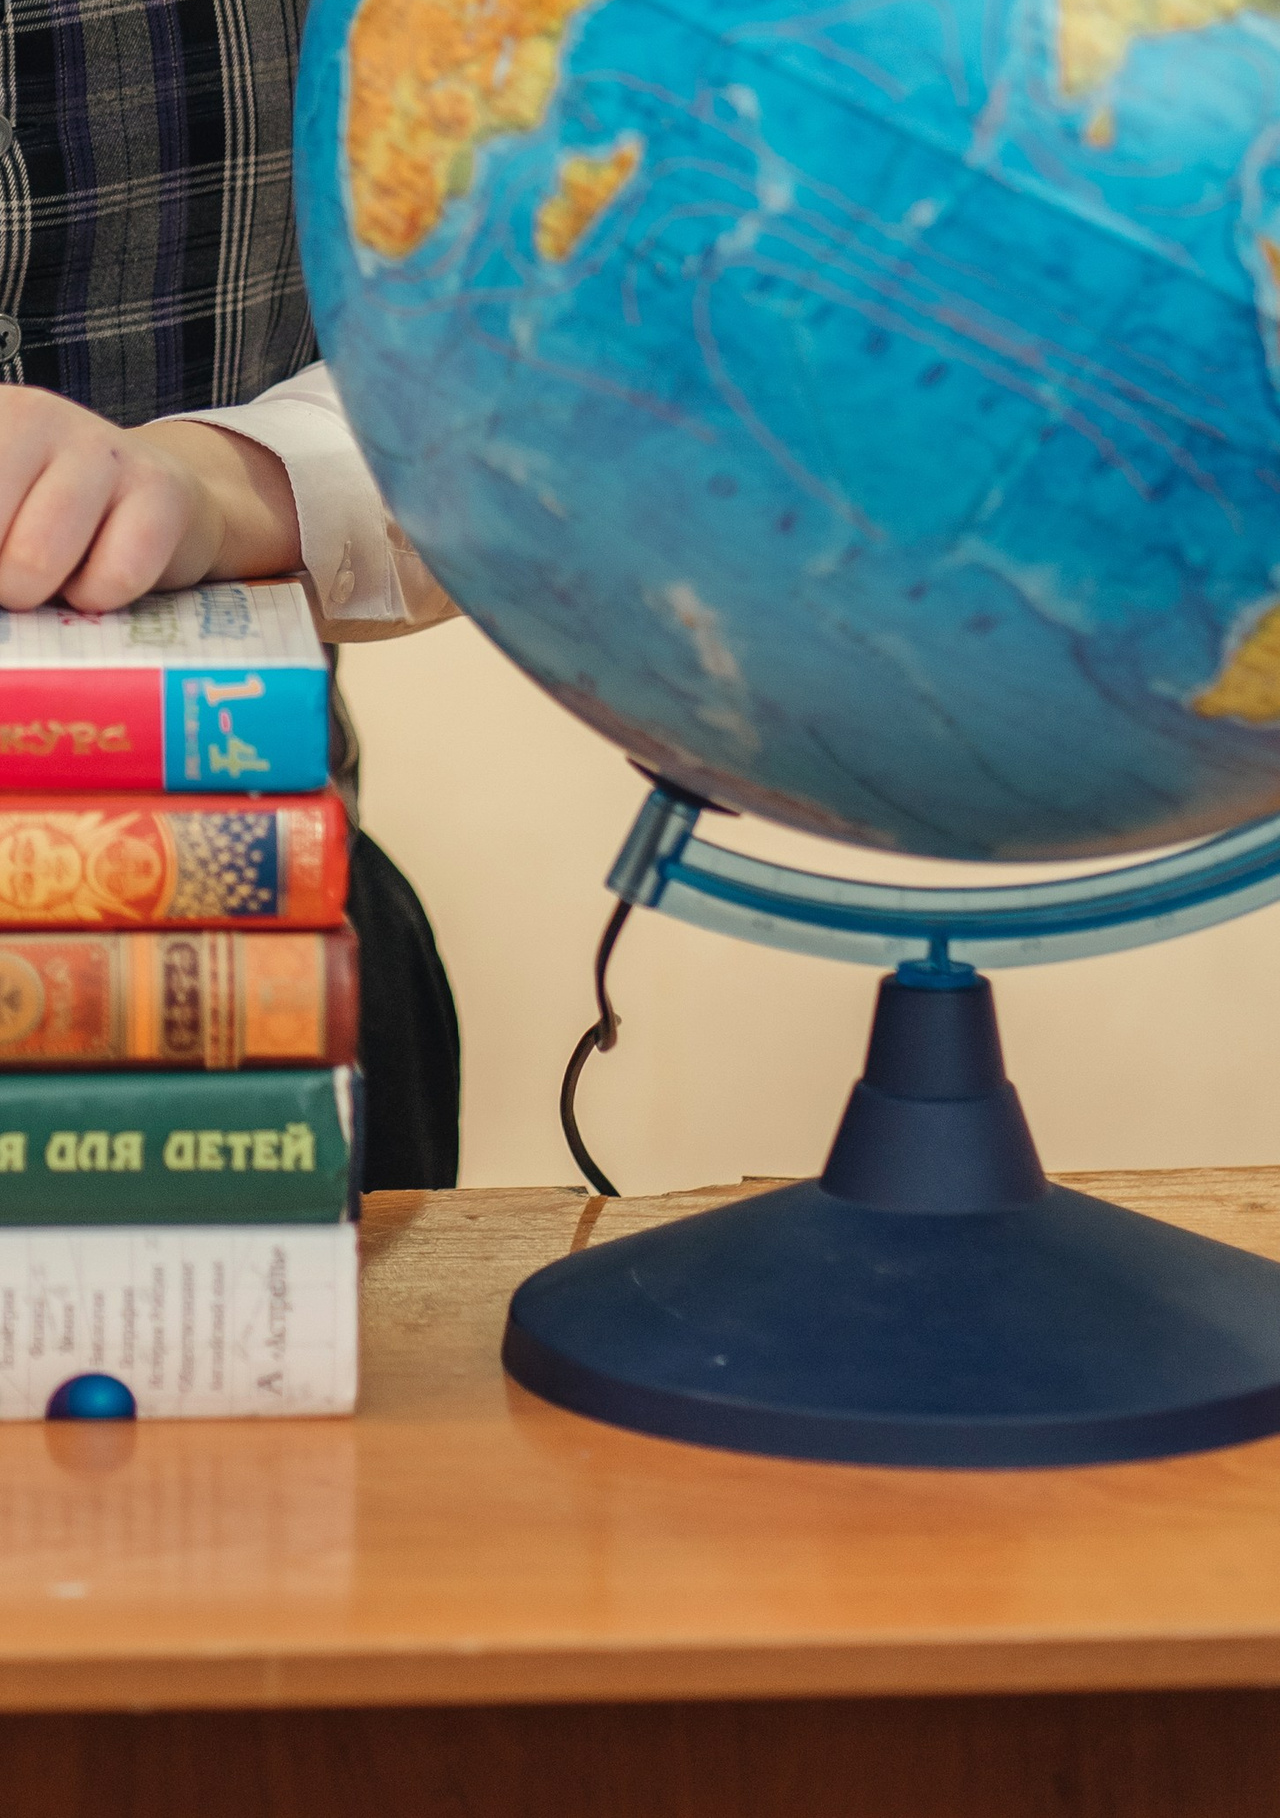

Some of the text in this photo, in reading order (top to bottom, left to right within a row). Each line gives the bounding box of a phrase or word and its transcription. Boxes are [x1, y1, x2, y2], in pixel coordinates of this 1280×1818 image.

[205, 673, 271, 779] 1-4
[45, 1129, 143, 1174] ДЛЯ
[162, 1123, 316, 1173] ДЕТЕЙ
